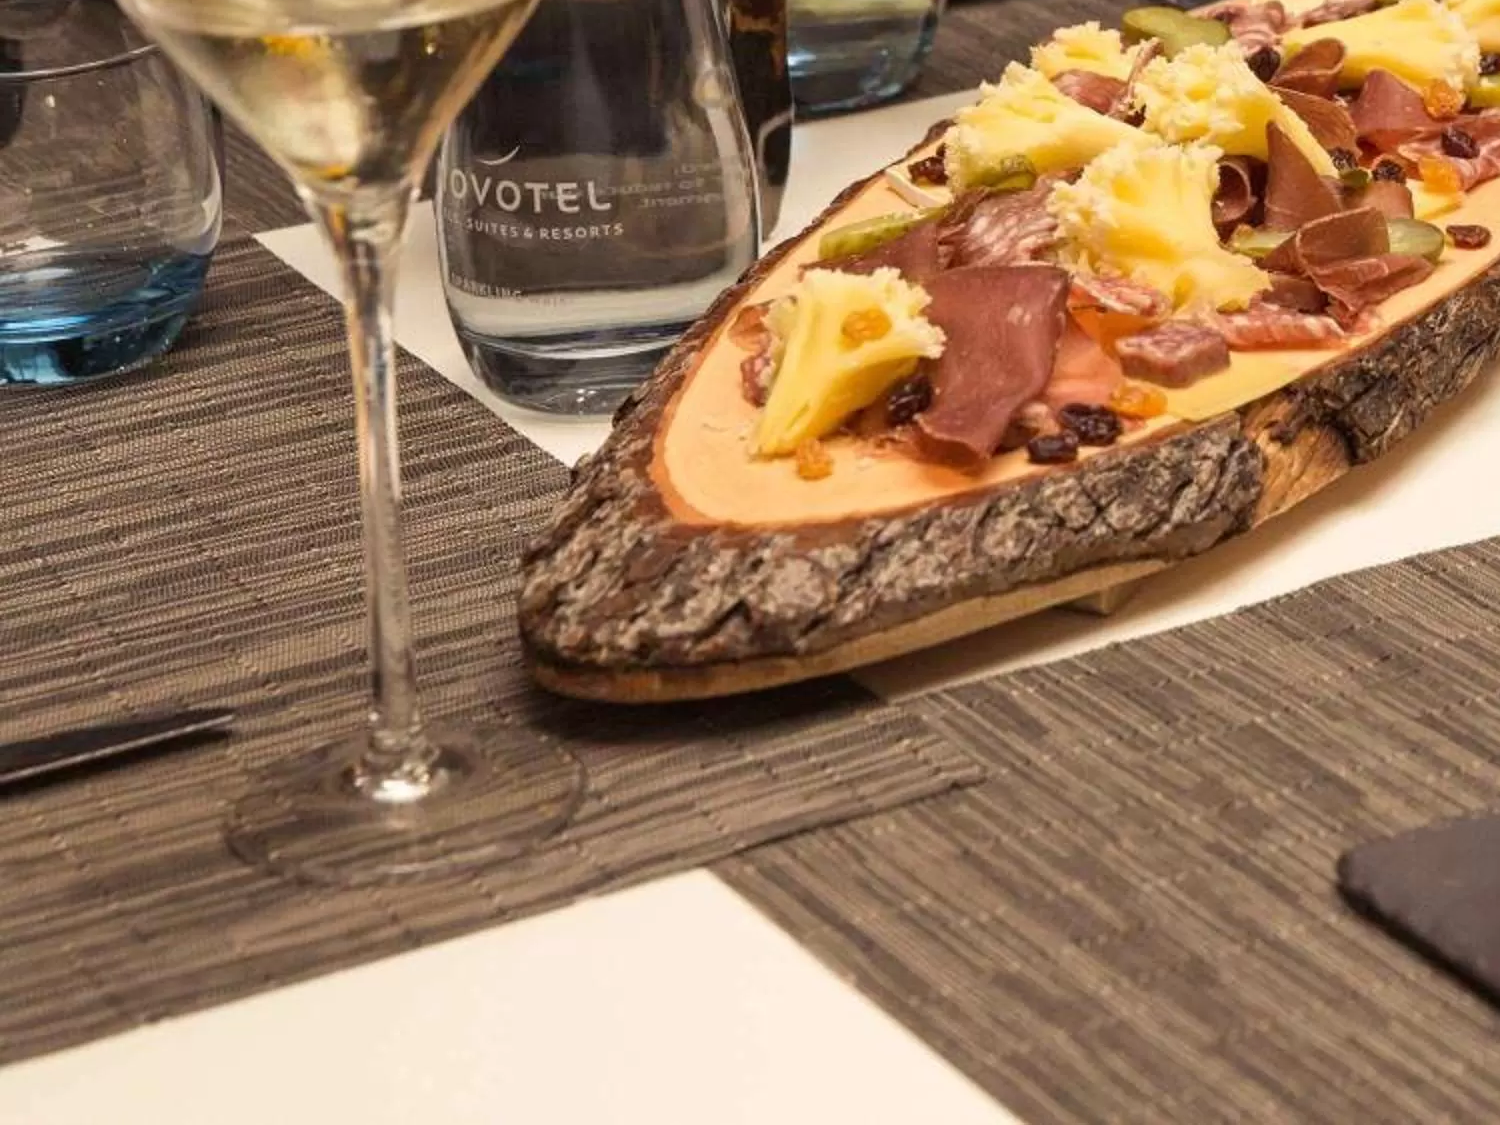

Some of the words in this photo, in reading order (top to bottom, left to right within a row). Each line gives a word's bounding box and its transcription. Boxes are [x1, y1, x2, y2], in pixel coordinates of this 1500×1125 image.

[450, 168, 612, 214] OVOTEL
[466, 218, 518, 239] SUITES
[523, 227, 534, 239] &
[539, 222, 625, 241] RESORTS
